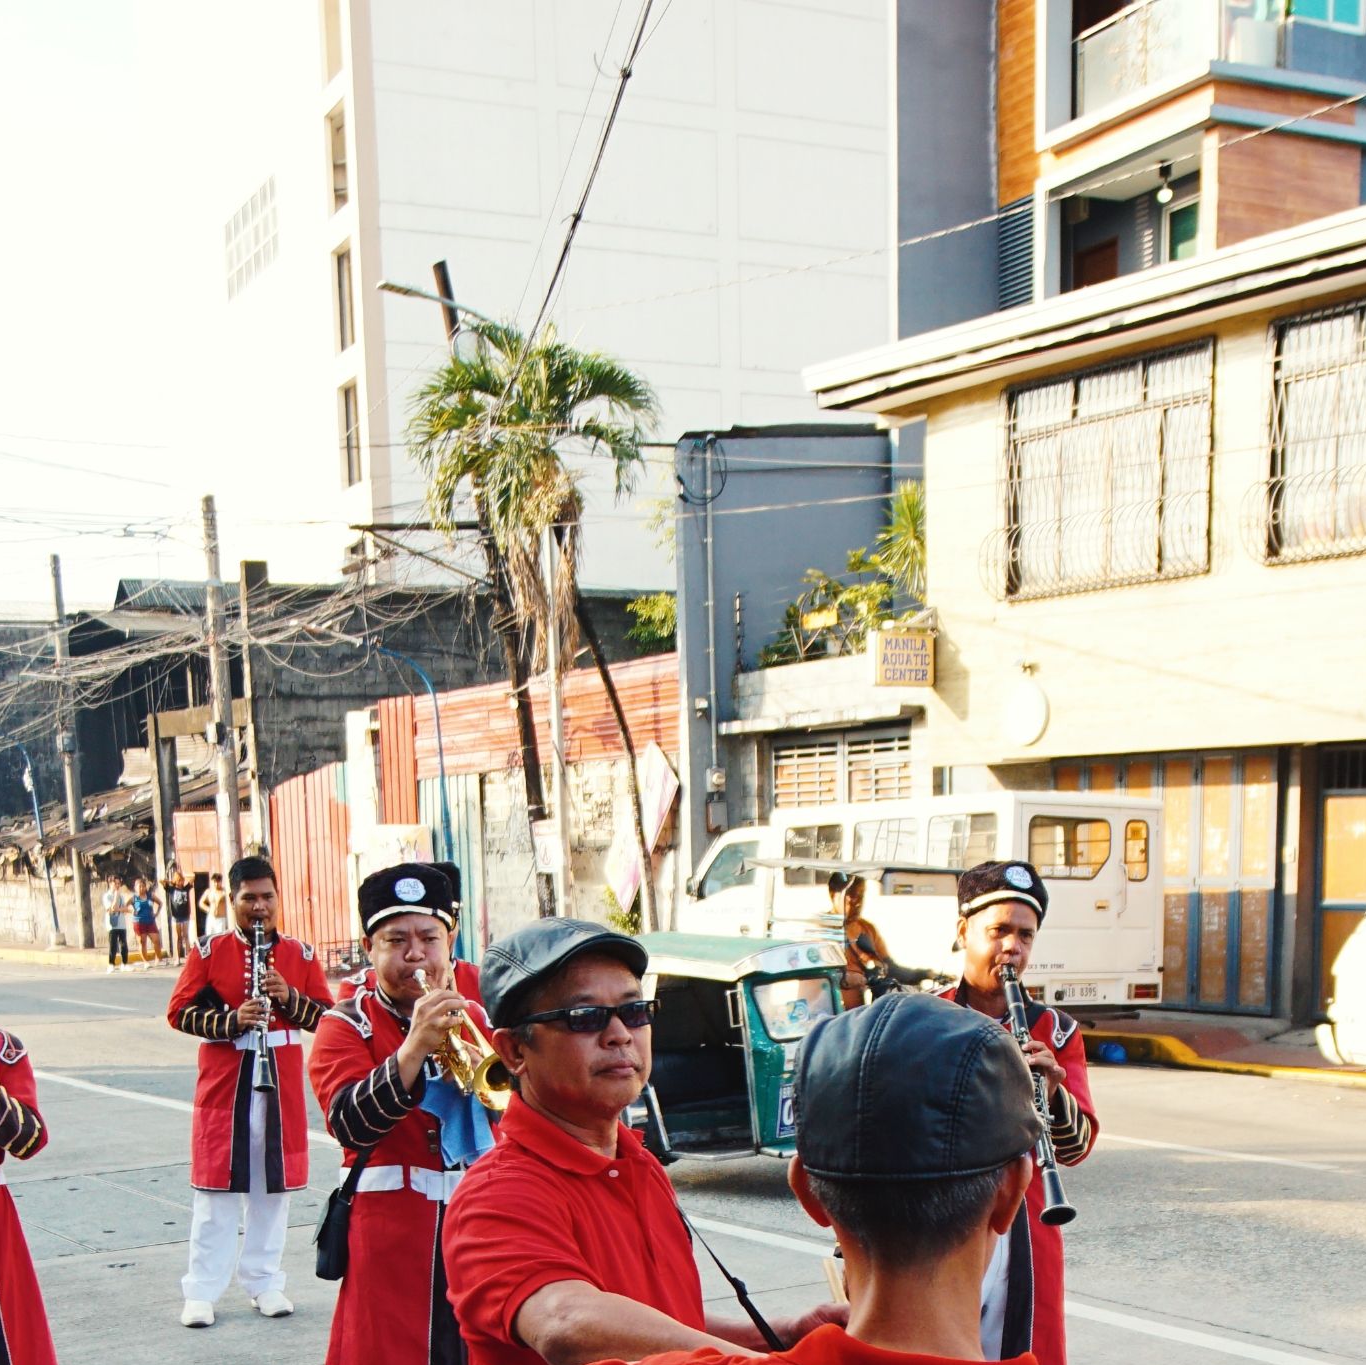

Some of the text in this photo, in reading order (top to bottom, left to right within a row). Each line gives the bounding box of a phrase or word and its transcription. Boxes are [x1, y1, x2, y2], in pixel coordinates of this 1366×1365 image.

[884, 637, 928, 652] MANILA
[882, 652, 931, 667] AQUATIC
[884, 668, 928, 682] CENTER
